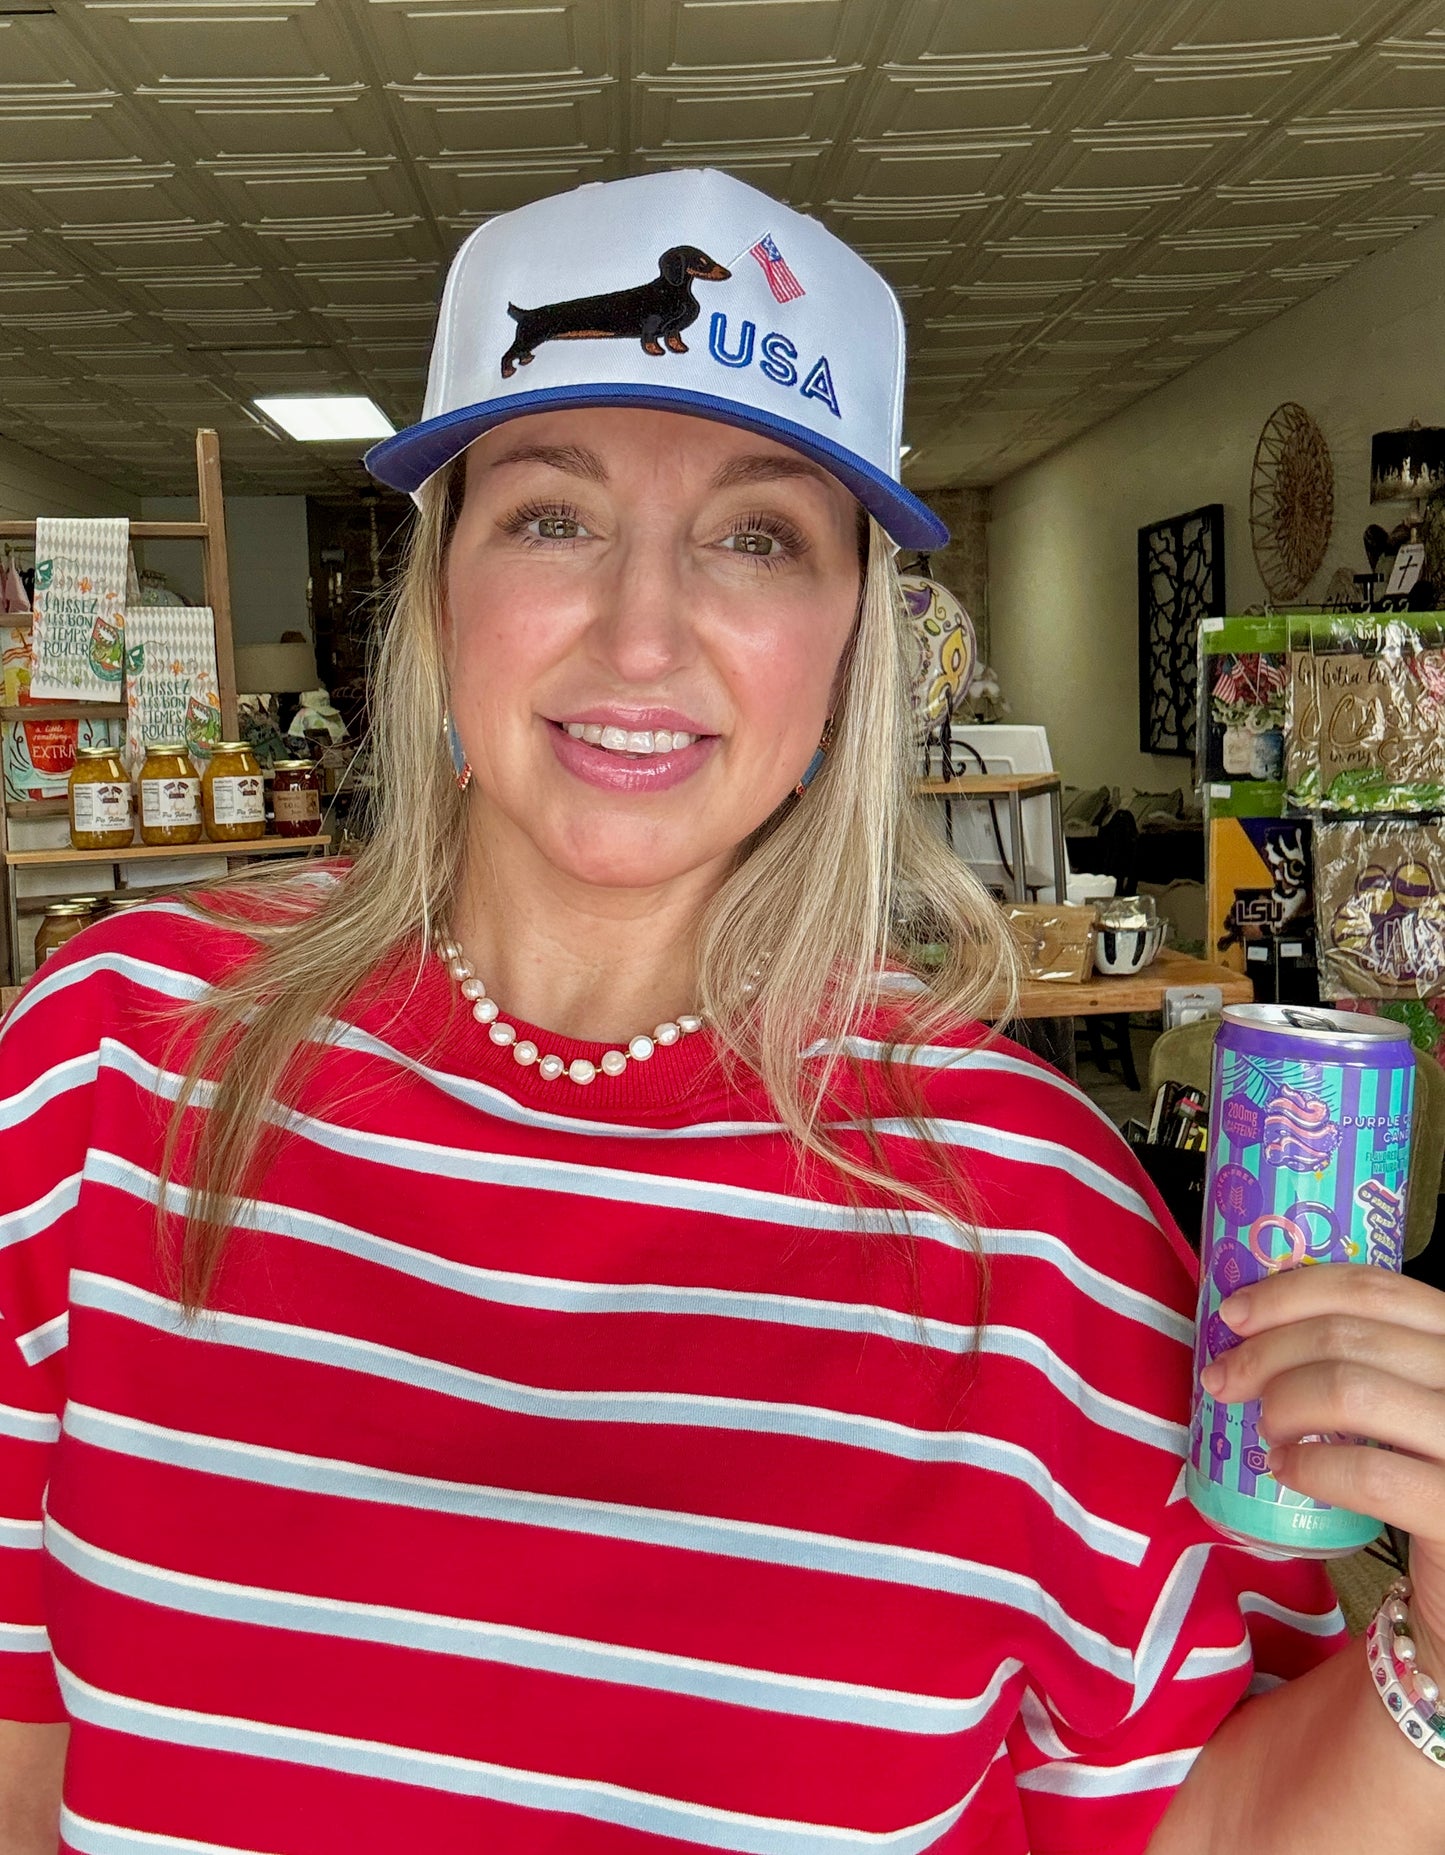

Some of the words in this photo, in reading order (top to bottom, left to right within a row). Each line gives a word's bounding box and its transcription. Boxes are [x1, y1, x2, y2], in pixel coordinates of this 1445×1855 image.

[708, 311, 842, 419] USA
[65, 613, 93, 629] BON
[47, 627, 88, 642] TEMPS
[43, 640, 89, 658] ROULER
[143, 710, 182, 724] TEMPS
[141, 724, 185, 741] ROULER
[32, 744, 77, 759] EXTRA
[1236, 899, 1284, 927] LSU
[1228, 1101, 1258, 1126] 200mg
[1342, 1115, 1400, 1129] PURPLE
